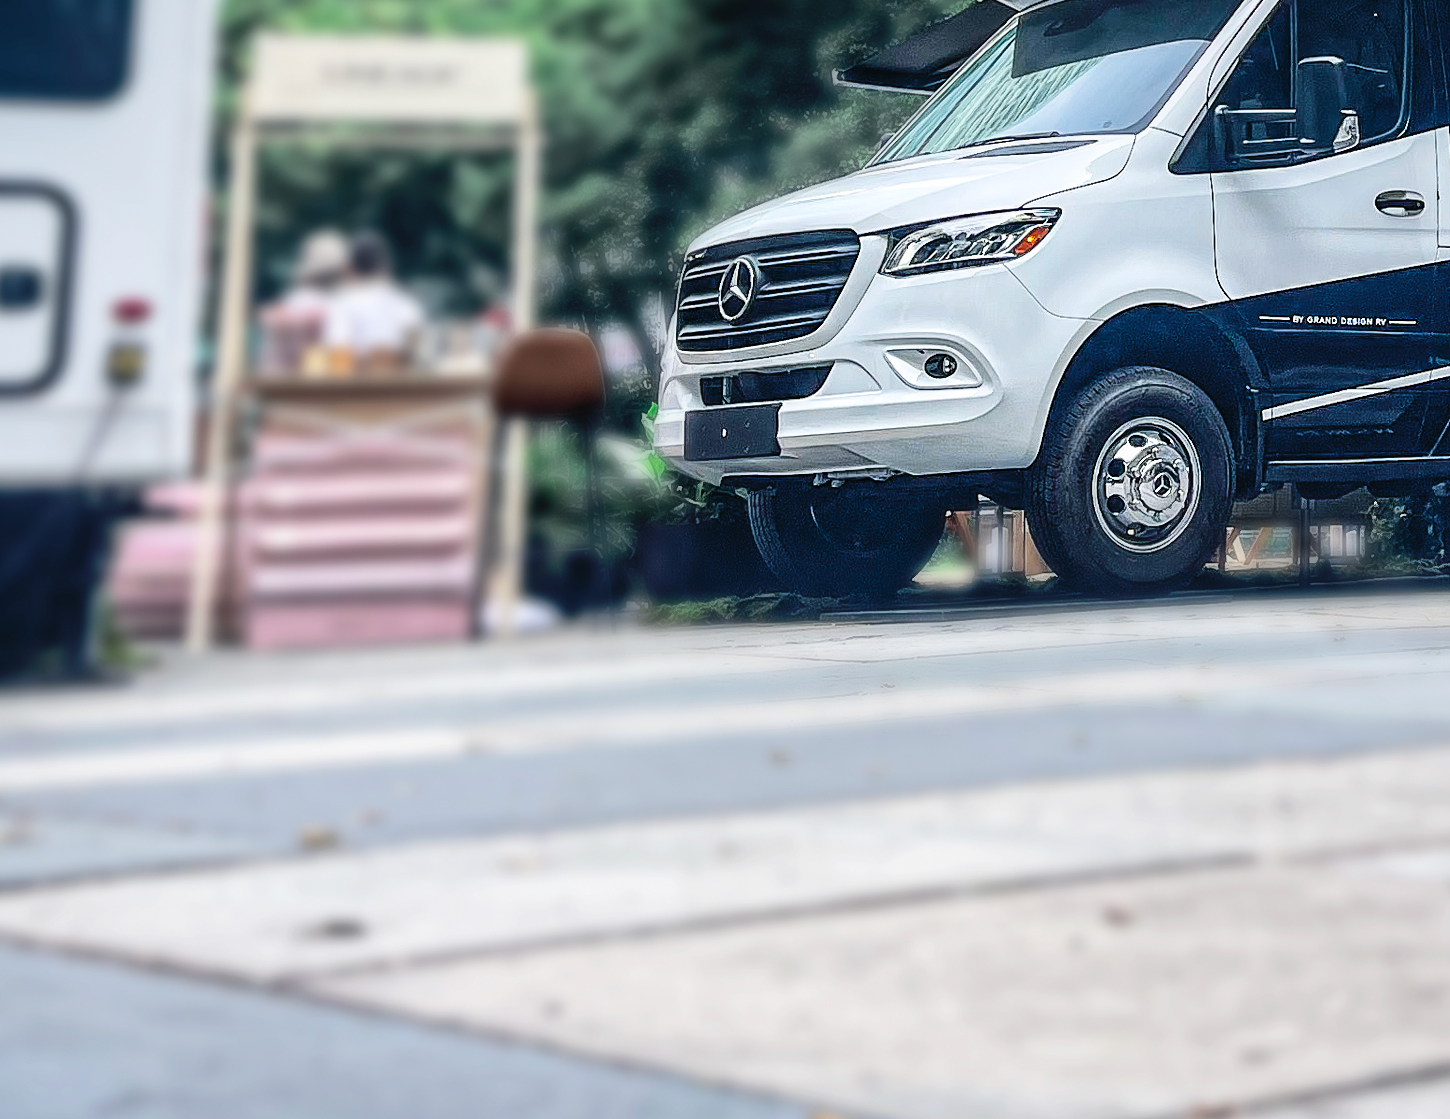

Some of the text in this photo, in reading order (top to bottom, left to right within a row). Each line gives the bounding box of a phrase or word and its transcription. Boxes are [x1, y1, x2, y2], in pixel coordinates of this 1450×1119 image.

[1292, 314, 1387, 326] BY GRAND DESIGN RV
